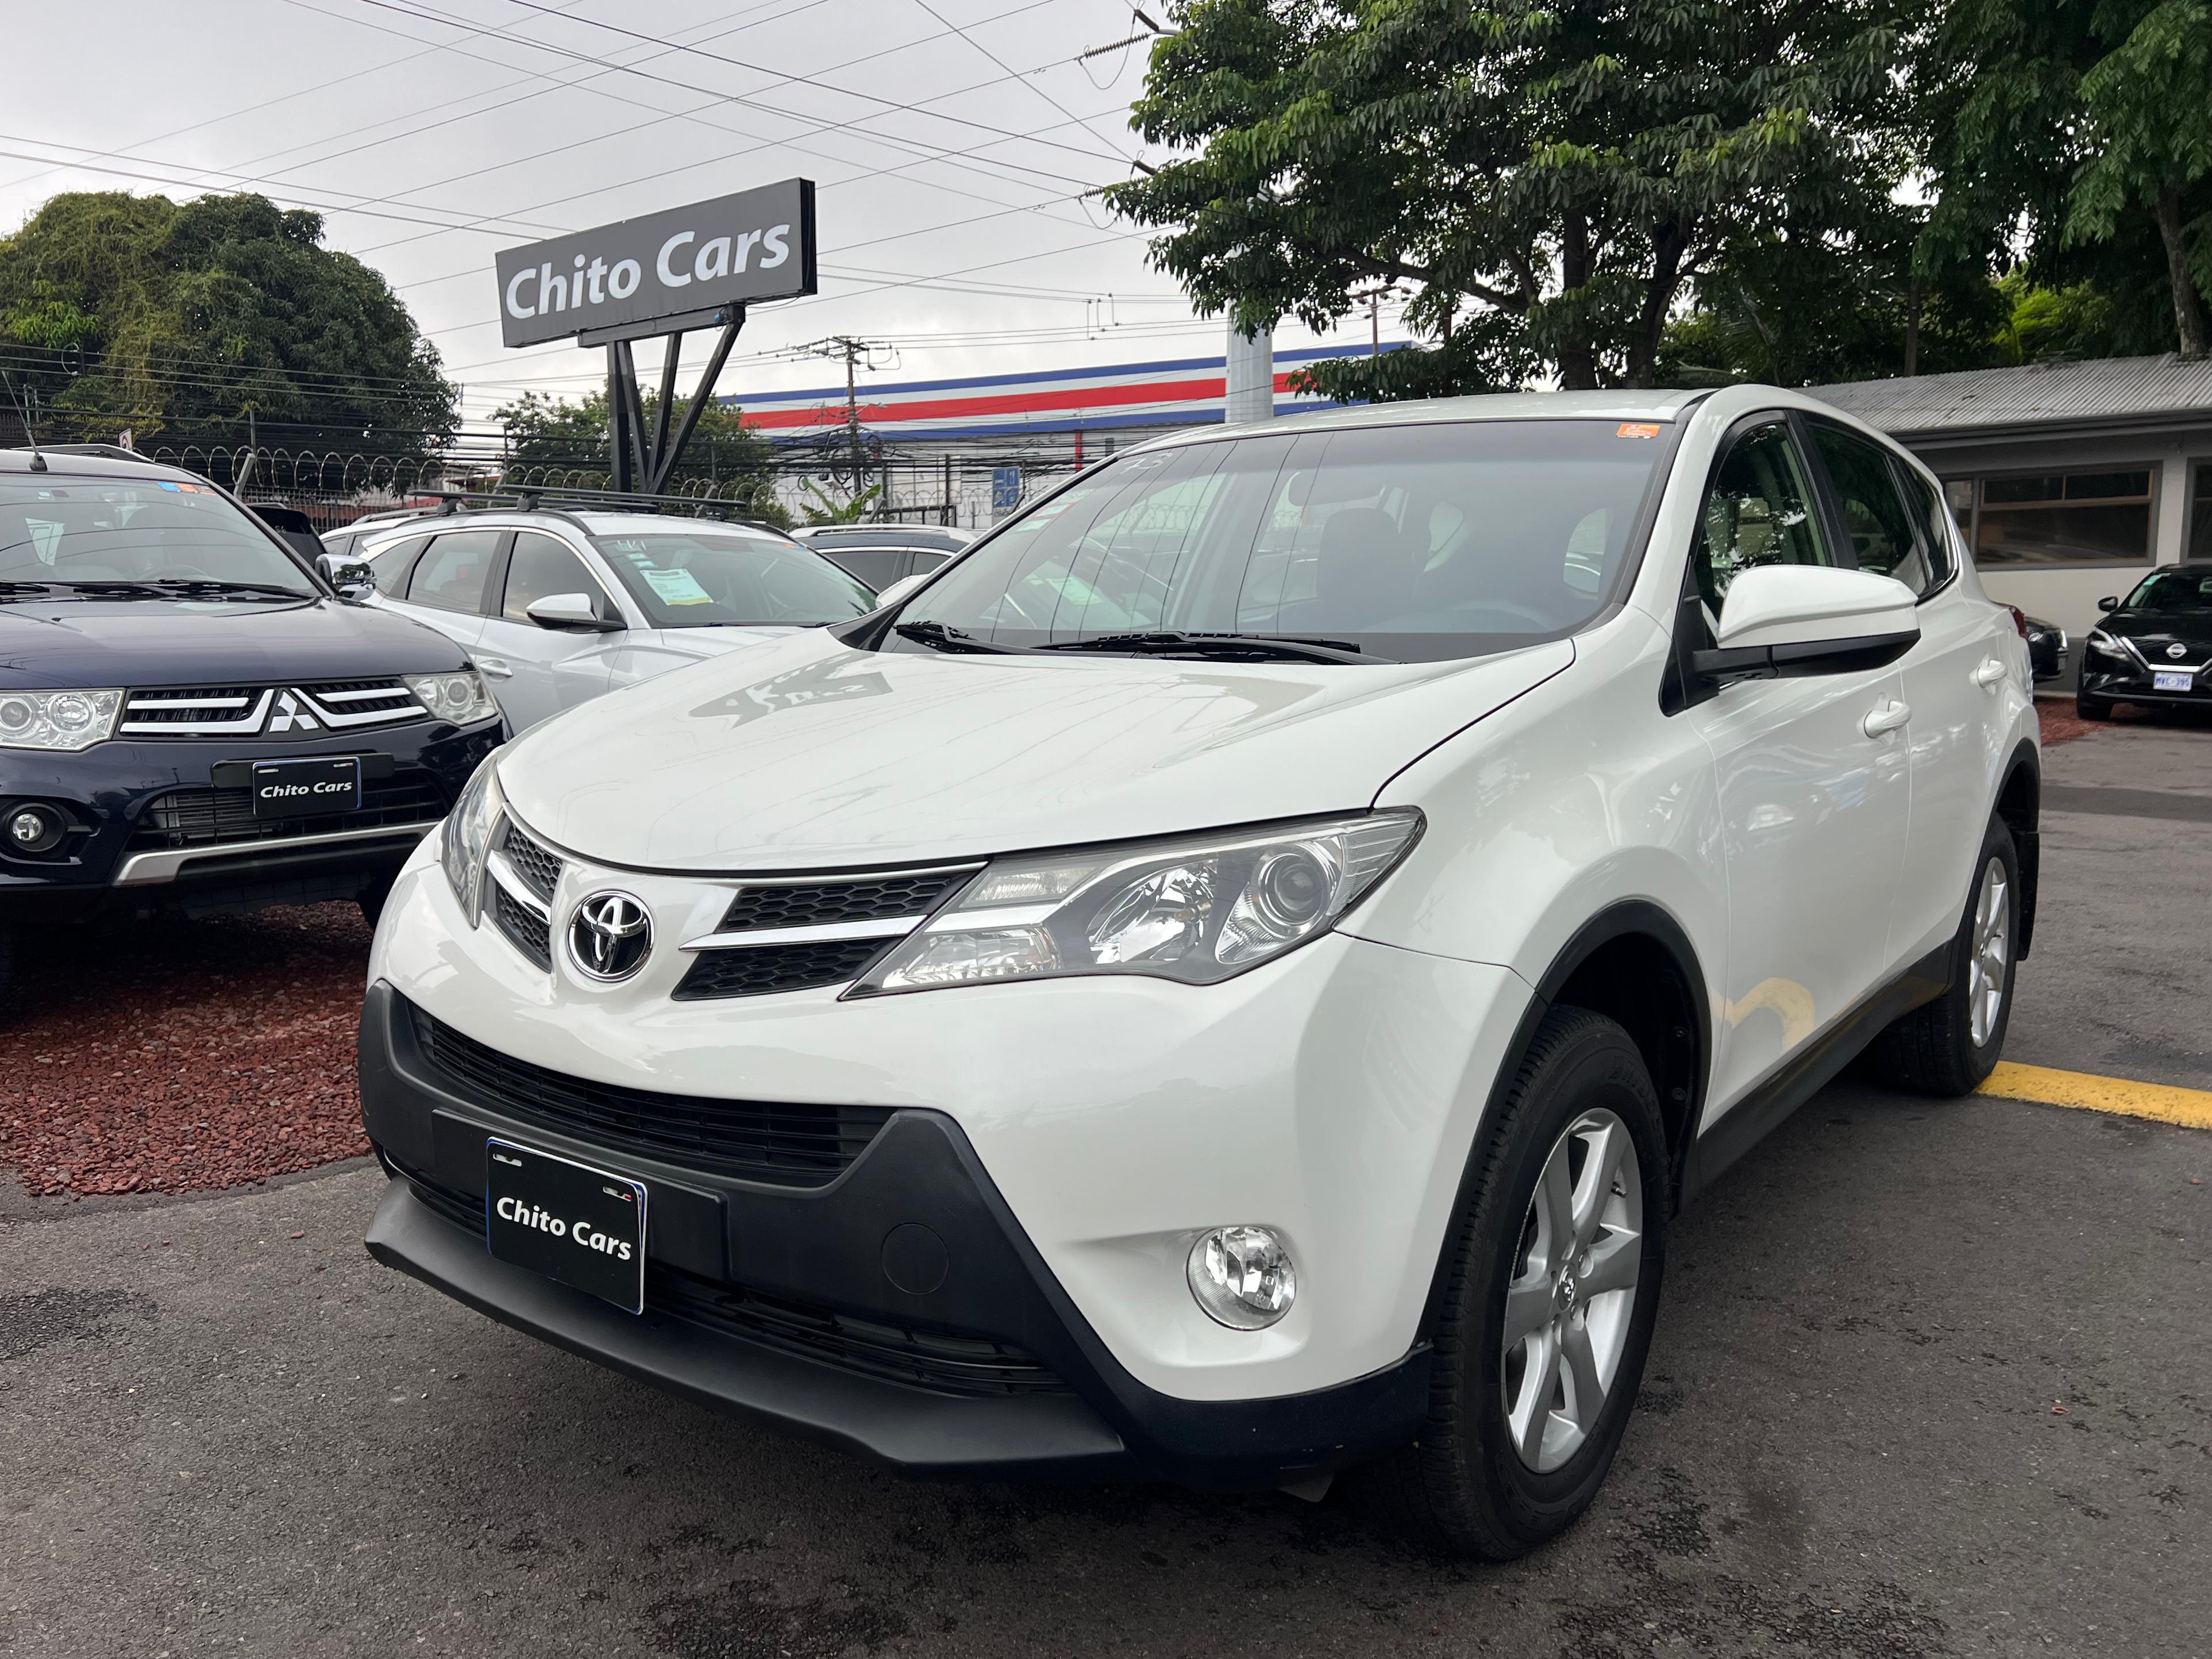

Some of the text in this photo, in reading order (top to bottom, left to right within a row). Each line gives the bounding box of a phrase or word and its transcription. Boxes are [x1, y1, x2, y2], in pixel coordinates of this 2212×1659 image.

[506, 223, 791, 320] Chito Cars
[260, 781, 353, 798] Chito Cars
[496, 1196, 632, 1261] Chito Cars
